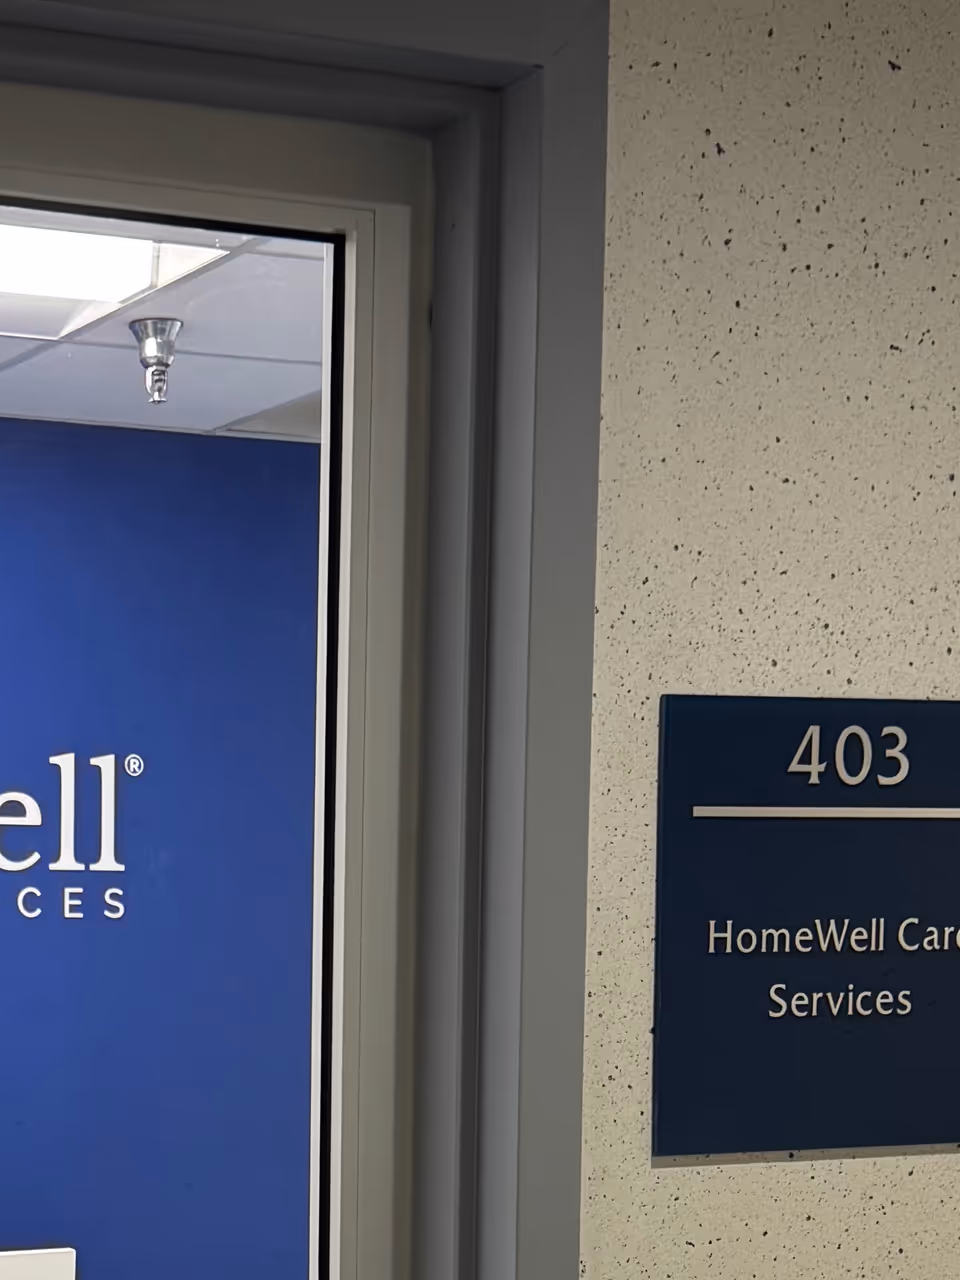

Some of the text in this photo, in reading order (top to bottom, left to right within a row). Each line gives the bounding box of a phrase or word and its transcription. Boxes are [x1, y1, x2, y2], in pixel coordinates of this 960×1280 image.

[787, 725, 910, 786] 403
[707, 917, 960, 954] HomeWell Car
[768, 983, 912, 1018] Services
